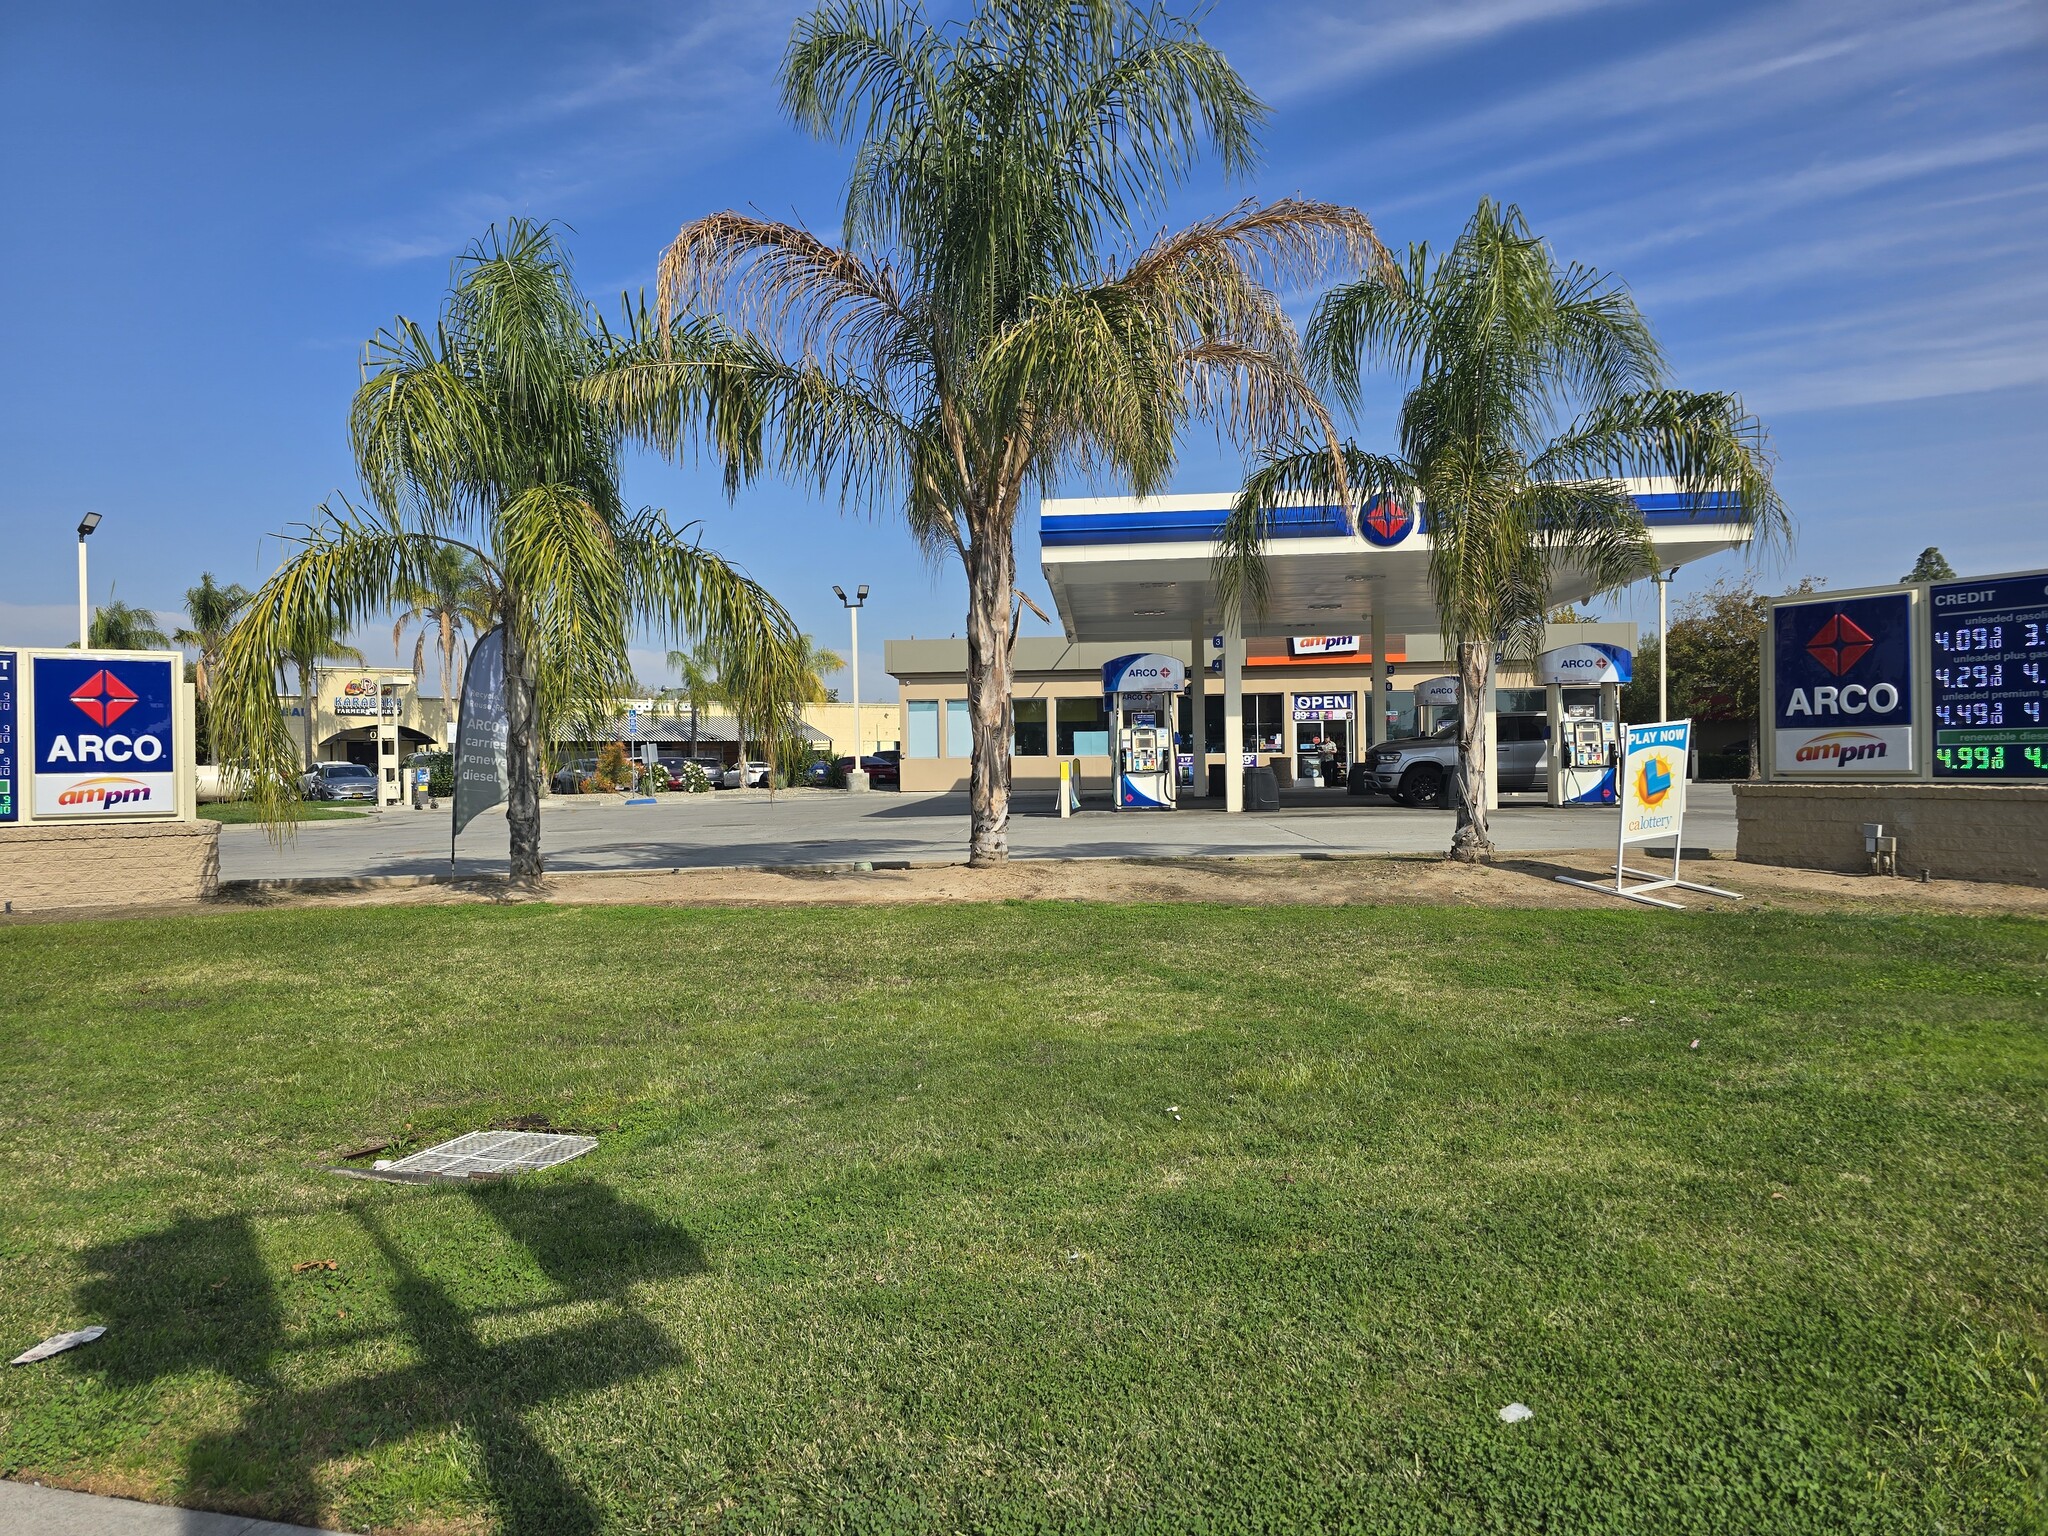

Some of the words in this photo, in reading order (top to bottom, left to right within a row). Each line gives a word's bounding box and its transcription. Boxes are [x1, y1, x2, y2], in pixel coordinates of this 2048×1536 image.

[1934, 590, 1996, 606] CREDIT
[1965, 614, 2013, 626] unleaded
[1300, 635, 1352, 650] ampm
[1934, 627, 1988, 652] 4.09
[1561, 660, 1593, 668] ARCO
[1954, 653, 2000, 664] unleaded
[2004, 651, 2026, 662] plus
[1128, 668, 1157, 678] ARCO
[1936, 665, 1988, 688] 4.29
[1298, 696, 1348, 709] OPEN
[1786, 683, 1898, 716] ARCO
[1942, 692, 1988, 702] unleaded
[1991, 690, 2040, 700] premium
[1936, 702, 1988, 726] 4.49
[466, 718, 500, 732] ARCO
[465, 737, 507, 751] carries
[1629, 732, 1658, 745] PLAY
[1660, 728, 1684, 742] NOW
[1960, 732, 2016, 742] renewable
[2020, 732, 2048, 740] diese
[47, 734, 162, 762] ARCO
[1796, 742, 1887, 767] ampm
[463, 754, 507, 767] renewa
[1936, 747, 1990, 770] 4.99
[463, 769, 501, 783] diesel.
[58, 787, 151, 810] ampm
[1629, 816, 1672, 832] calottery
